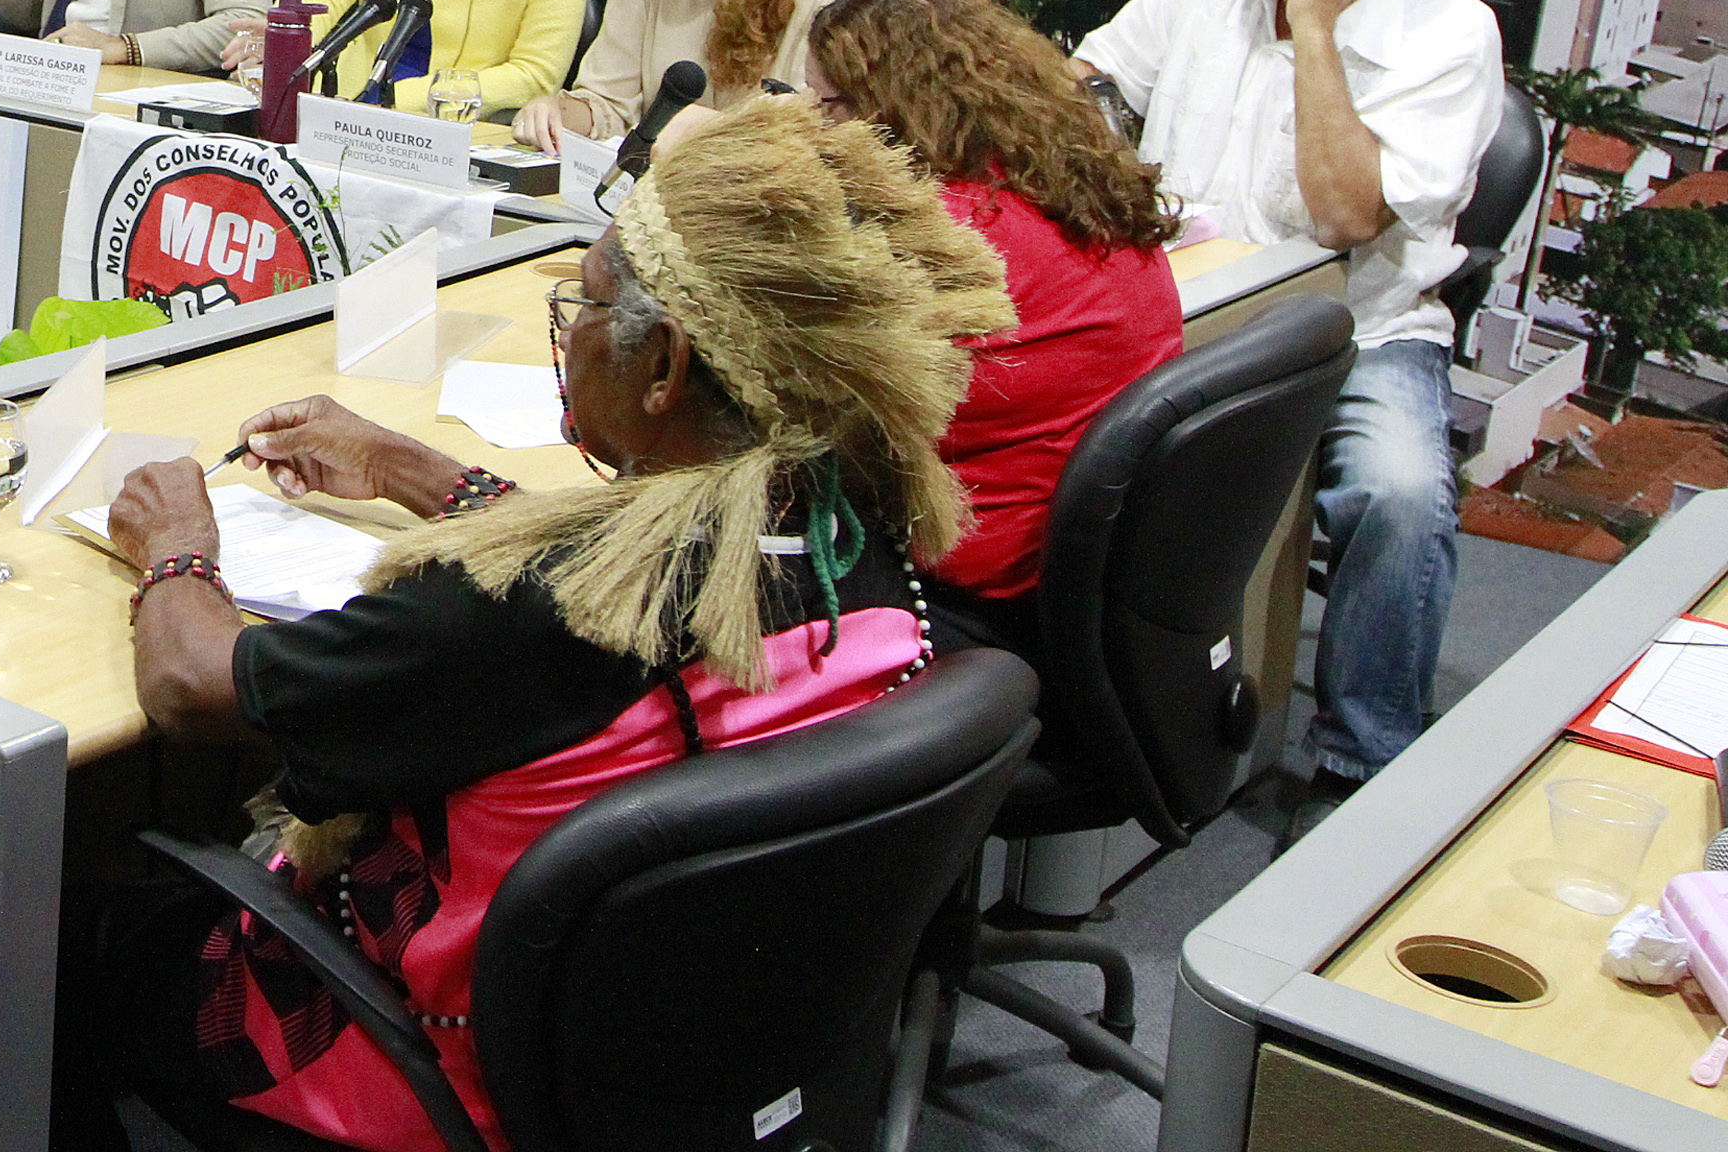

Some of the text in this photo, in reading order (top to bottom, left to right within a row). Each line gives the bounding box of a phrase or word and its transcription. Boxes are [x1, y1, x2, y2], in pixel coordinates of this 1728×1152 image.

[5, 52, 44, 67] LARISSA
[47, 58, 86, 74] GASPAR
[5, 64, 39, 78] COMISSÃO
[41, 70, 50, 79] DE
[52, 72, 87, 86] PROTEÇÃO
[7, 75, 11, 83] E
[12, 76, 43, 89] COMBATE
[44, 81, 50, 89] A
[51, 82, 69, 94] FOME
[71, 87, 76, 95] E
[9, 87, 19, 96] DO
[20, 88, 72, 106] REQUERIMENTO
[334, 120, 433, 150] PAULA QUEIROZ
[313, 130, 455, 167] REPRESENTANDO SECRETARIA DE
[343, 148, 421, 173] PROTEÇÃO SOCIAL
[106, 216, 130, 276] MOV.
[123, 166, 152, 212] DOS
[155, 144, 280, 187] CONSELHOS
[159, 192, 277, 284] MCP
